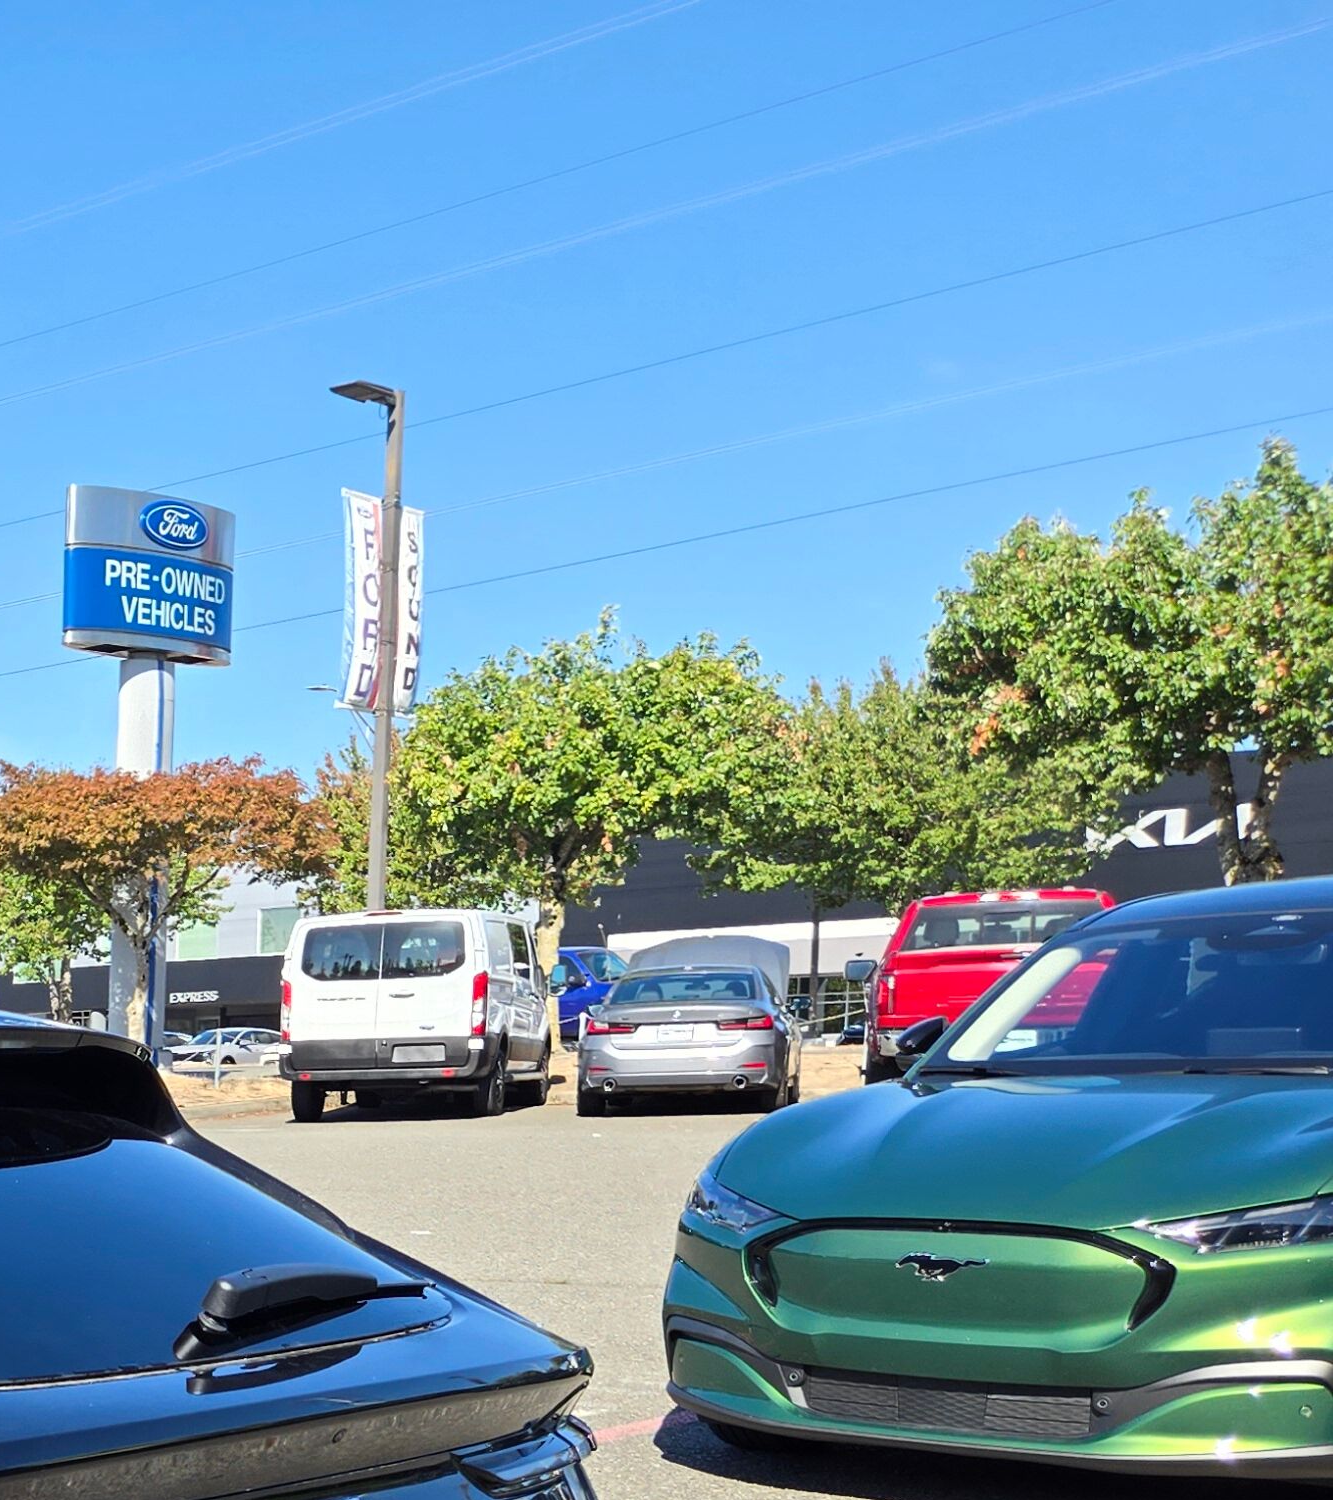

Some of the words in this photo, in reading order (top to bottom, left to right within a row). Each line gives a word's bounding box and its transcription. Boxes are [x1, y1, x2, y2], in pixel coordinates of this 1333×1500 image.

[158, 508, 200, 541] Ford
[104, 558, 226, 605] PRE-OWNED
[120, 594, 216, 636] VEHICLES
[403, 531, 421, 691] SOUND
[169, 991, 220, 1004] EXPRESS
